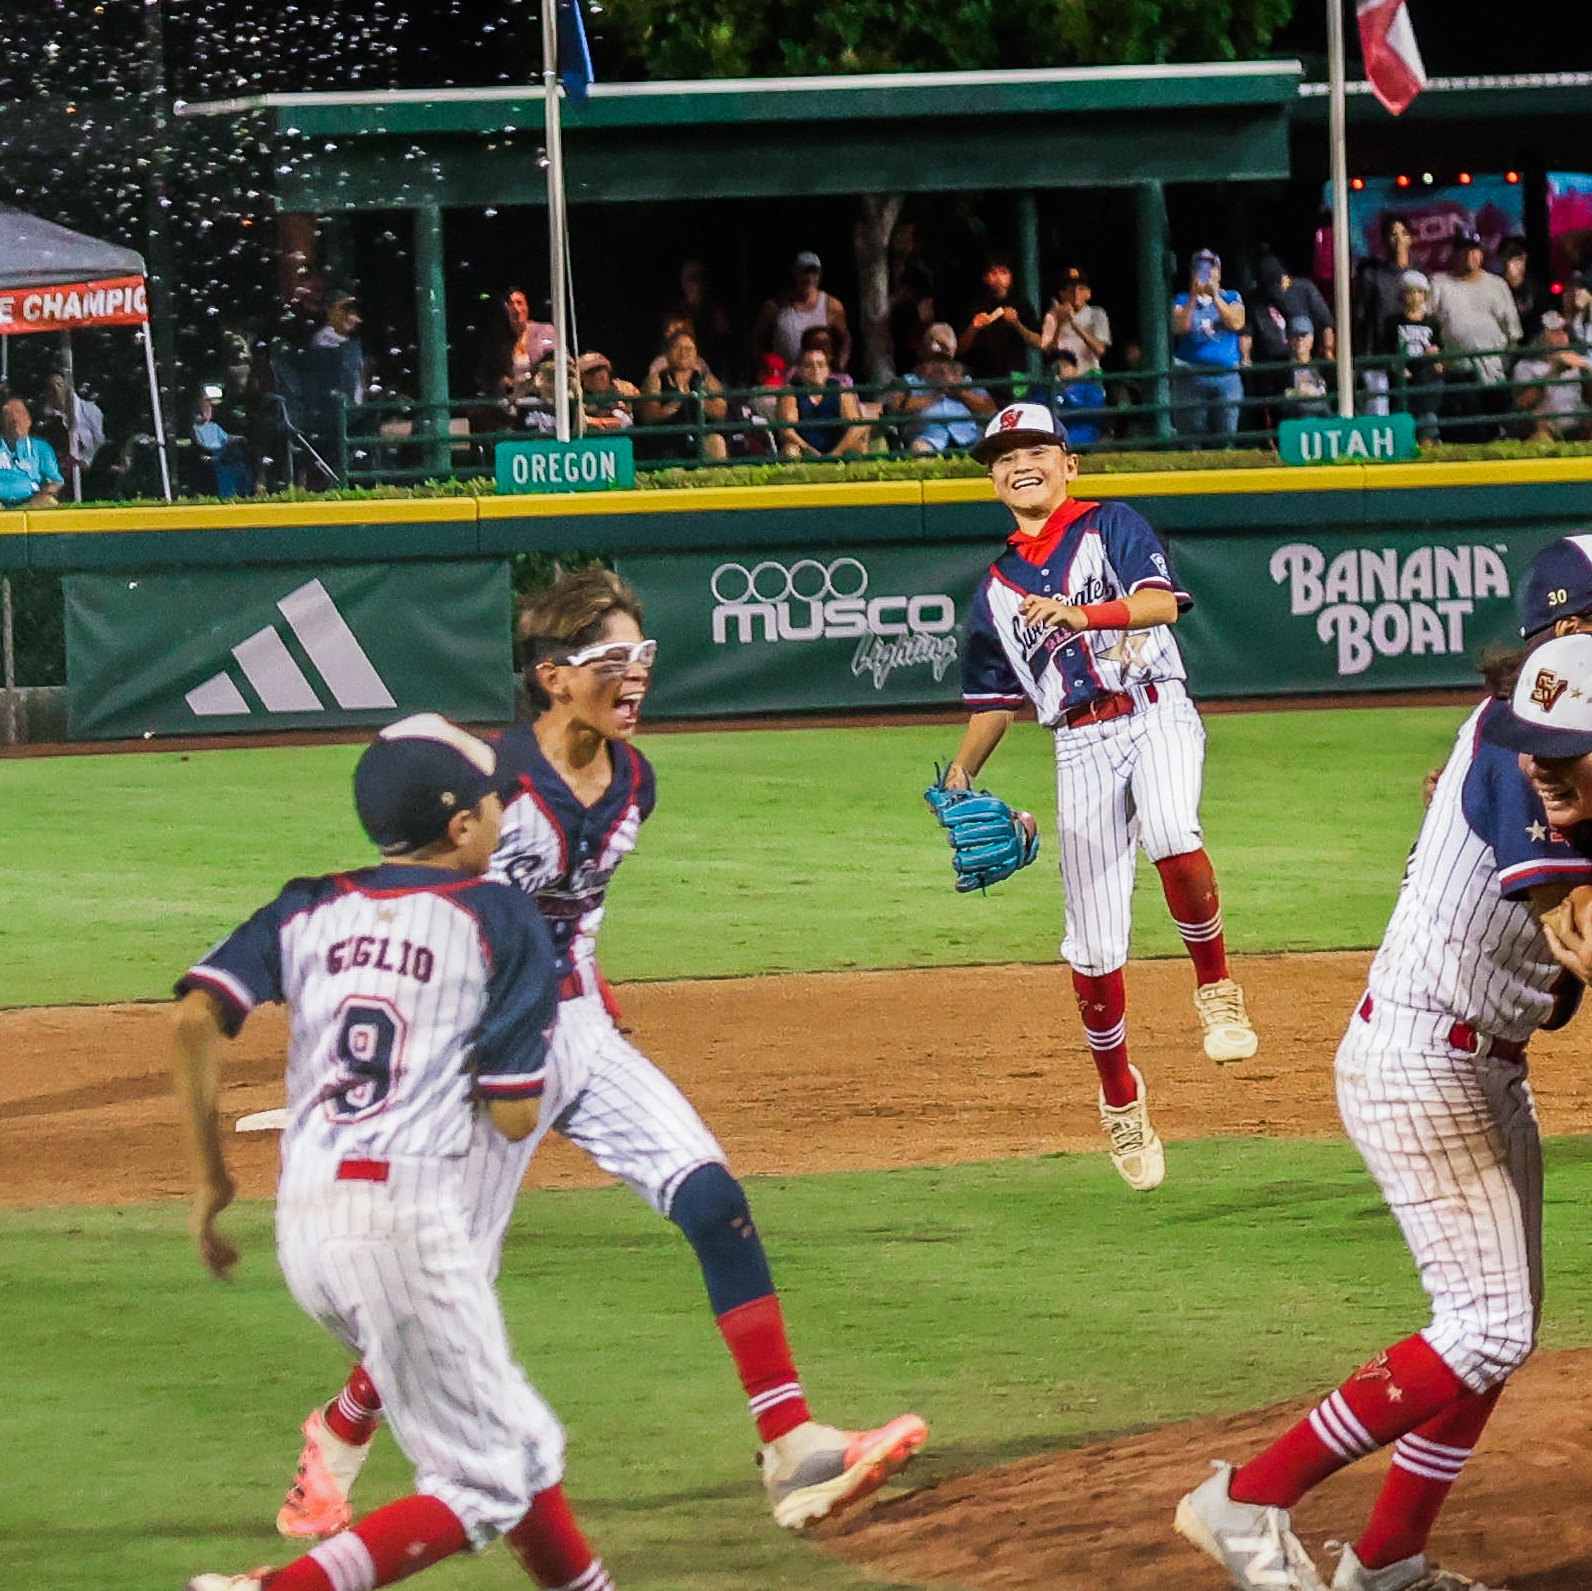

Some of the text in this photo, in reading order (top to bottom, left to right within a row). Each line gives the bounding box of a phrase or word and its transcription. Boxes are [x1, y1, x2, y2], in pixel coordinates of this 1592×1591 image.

[512, 451, 616, 485] OREGON
[1300, 427, 1394, 460] UTAH
[1269, 542, 1510, 615] BANANA
[1547, 589, 1567, 606] 30
[1317, 600, 1474, 675] BOAT
[326, 934, 434, 984] GGLIO
[321, 994, 409, 1125] 9
